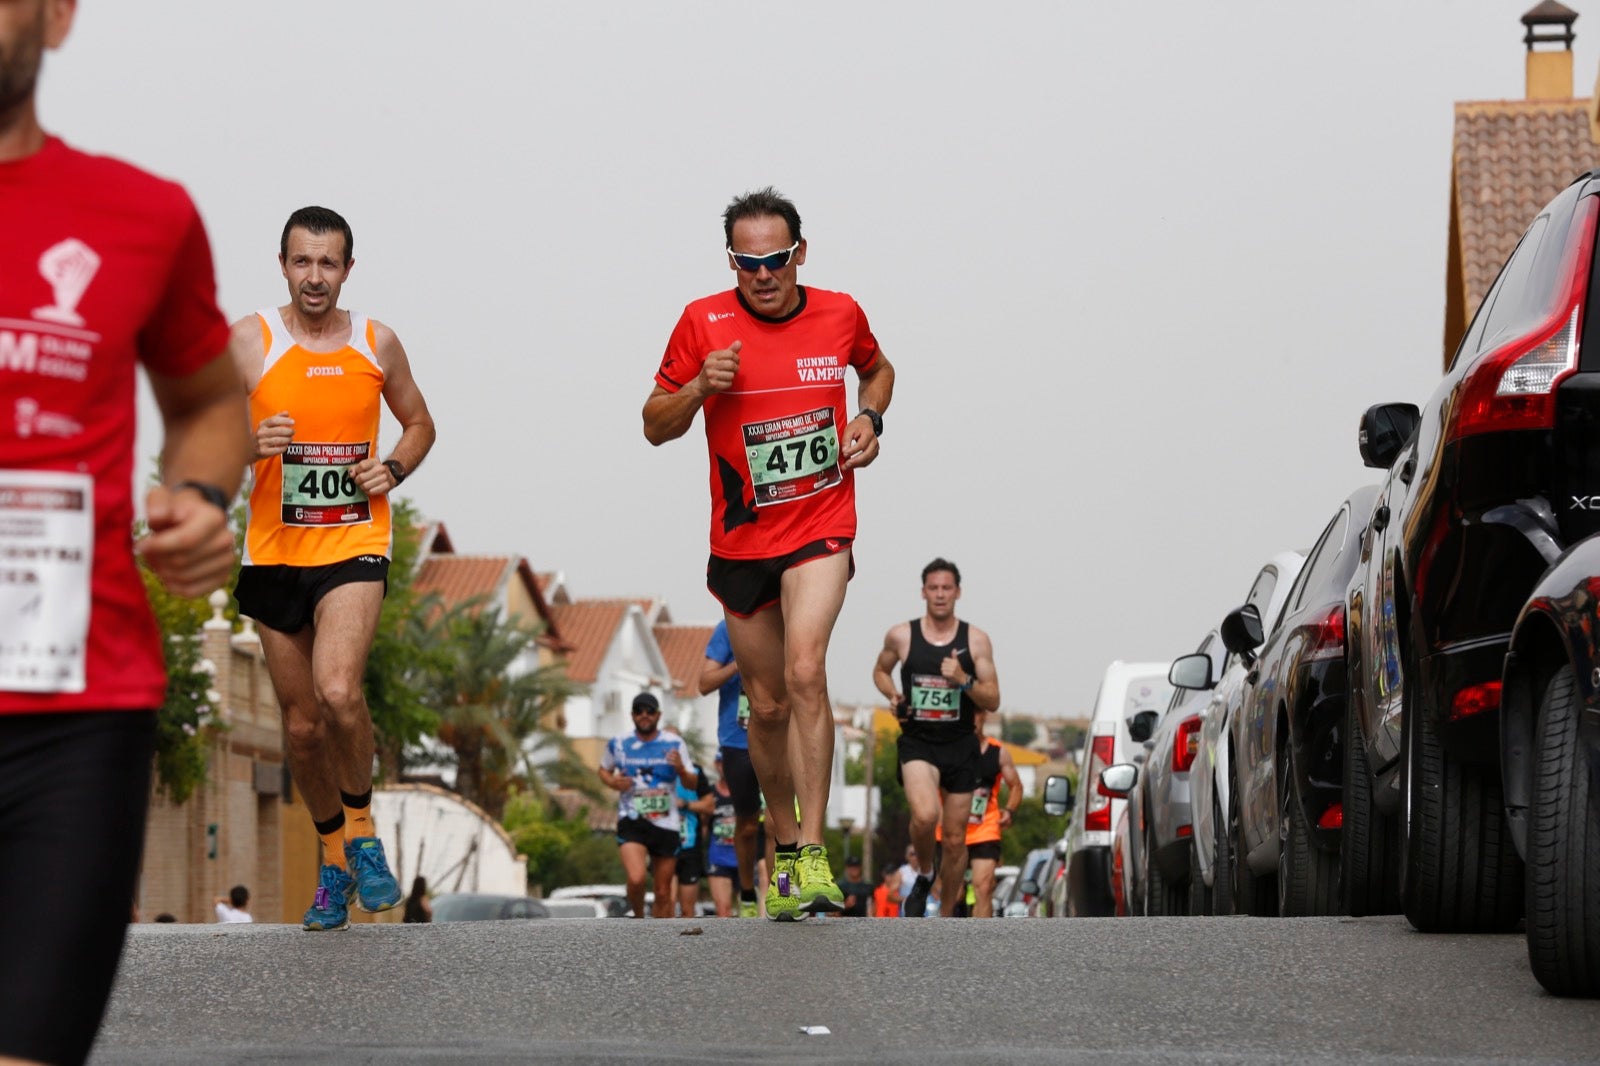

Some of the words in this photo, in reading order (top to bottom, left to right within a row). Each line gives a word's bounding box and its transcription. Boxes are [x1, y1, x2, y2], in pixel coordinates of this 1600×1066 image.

[796, 356, 838, 368] RUNNING
[748, 424, 765, 436] XXXII
[764, 420, 782, 433] GRAN
[781, 415, 804, 430] PREMIO
[804, 413, 813, 424] DE
[813, 408, 830, 421] FONDO
[286, 444, 303, 455] XXXII
[303, 445, 321, 456] GRAN
[321, 445, 345, 456] PREMIO
[345, 445, 353, 456] DE
[766, 435, 829, 474] 476
[298, 469, 356, 499] 406
[919, 690, 953, 707] 754
